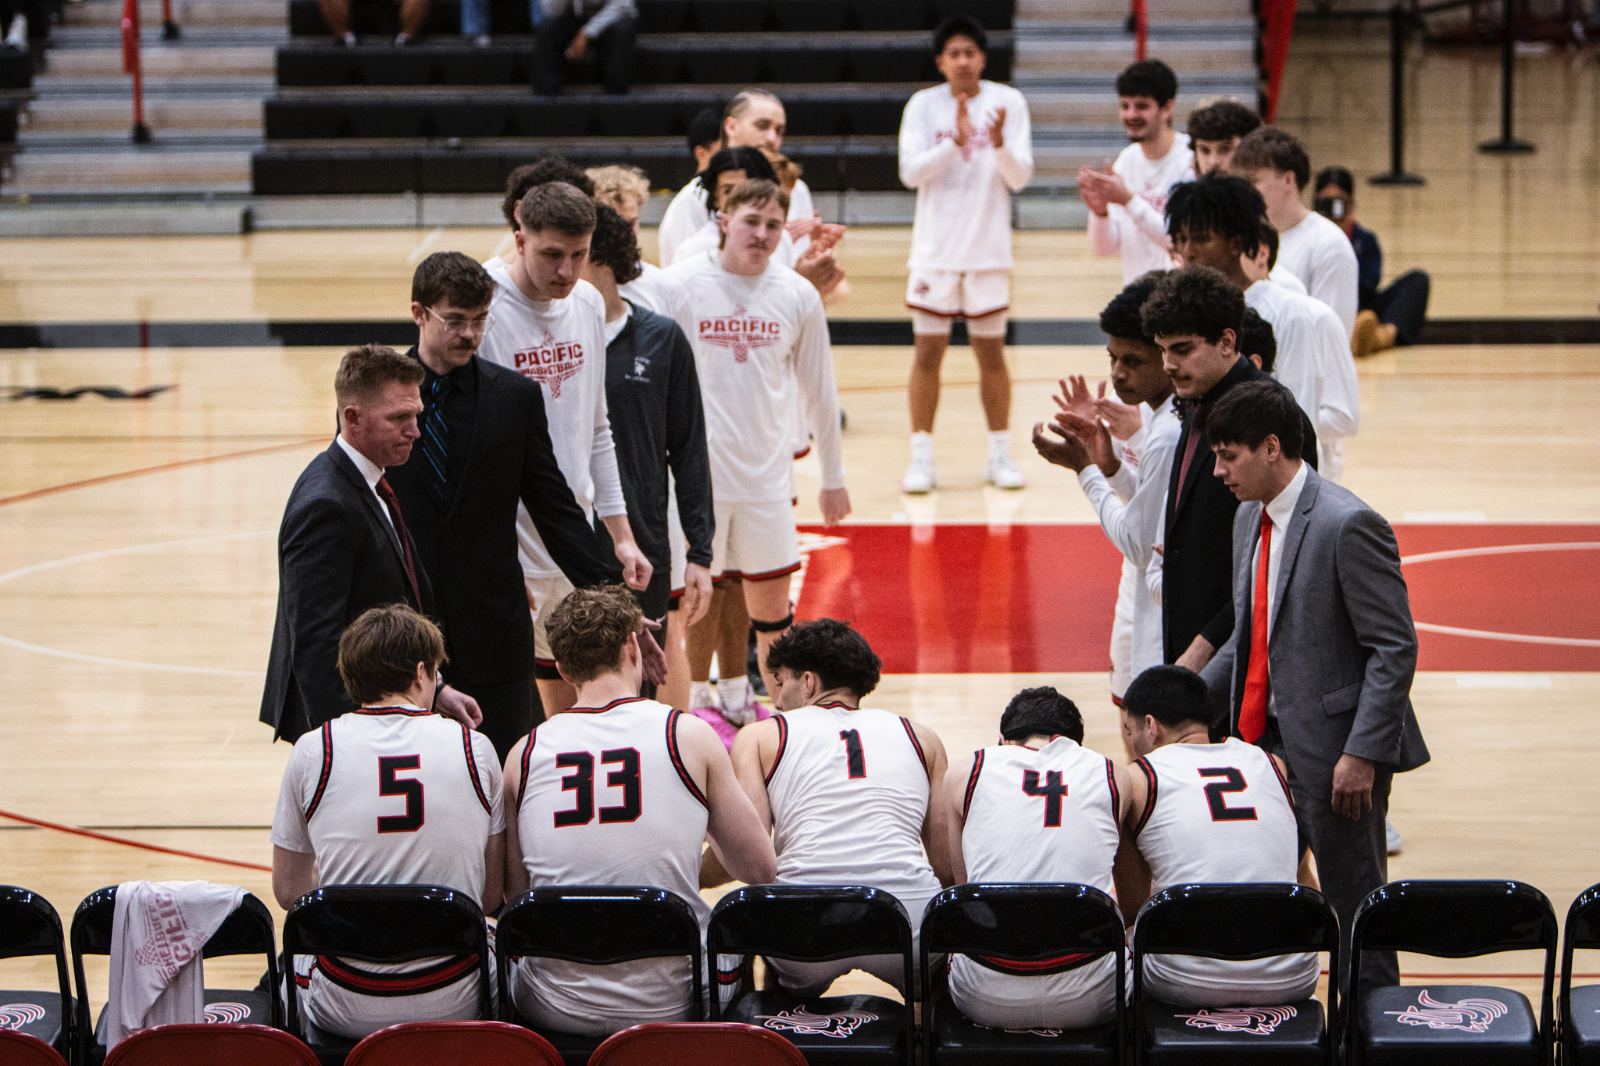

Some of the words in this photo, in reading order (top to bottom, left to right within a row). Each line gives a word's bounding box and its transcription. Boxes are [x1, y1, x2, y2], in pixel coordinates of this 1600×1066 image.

[699, 320, 780, 334] PACIFIC
[514, 344, 583, 368] PACIFIC
[839, 728, 866, 779] 1
[377, 754, 425, 834] 5
[554, 747, 642, 828] 33
[1022, 769, 1068, 827] 4
[1197, 766, 1258, 822] 2
